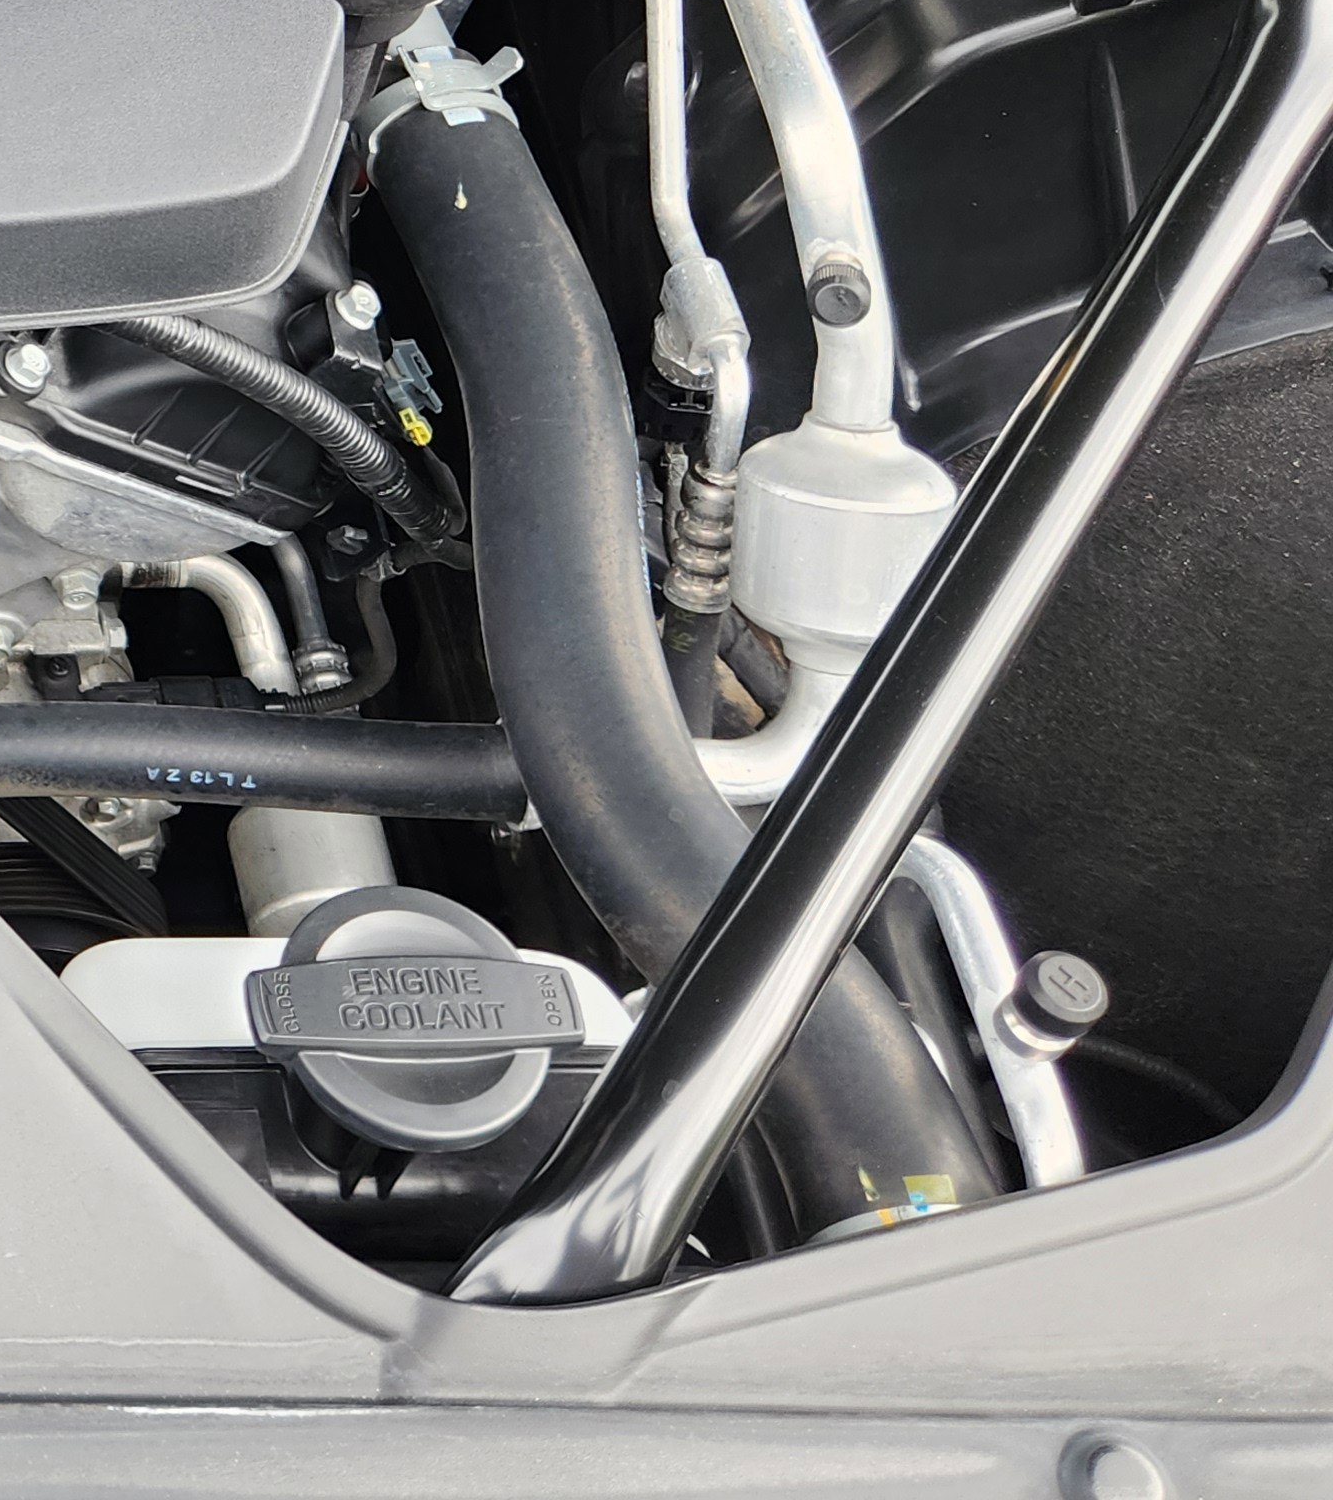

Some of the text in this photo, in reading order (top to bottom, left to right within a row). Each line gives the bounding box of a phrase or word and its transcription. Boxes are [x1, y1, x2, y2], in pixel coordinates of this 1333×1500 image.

[348, 966, 483, 996] ENGINE
[536, 973, 563, 1027] OPEN
[273, 972, 301, 1034] CLOSE
[338, 1000, 506, 1031] COOLANT
